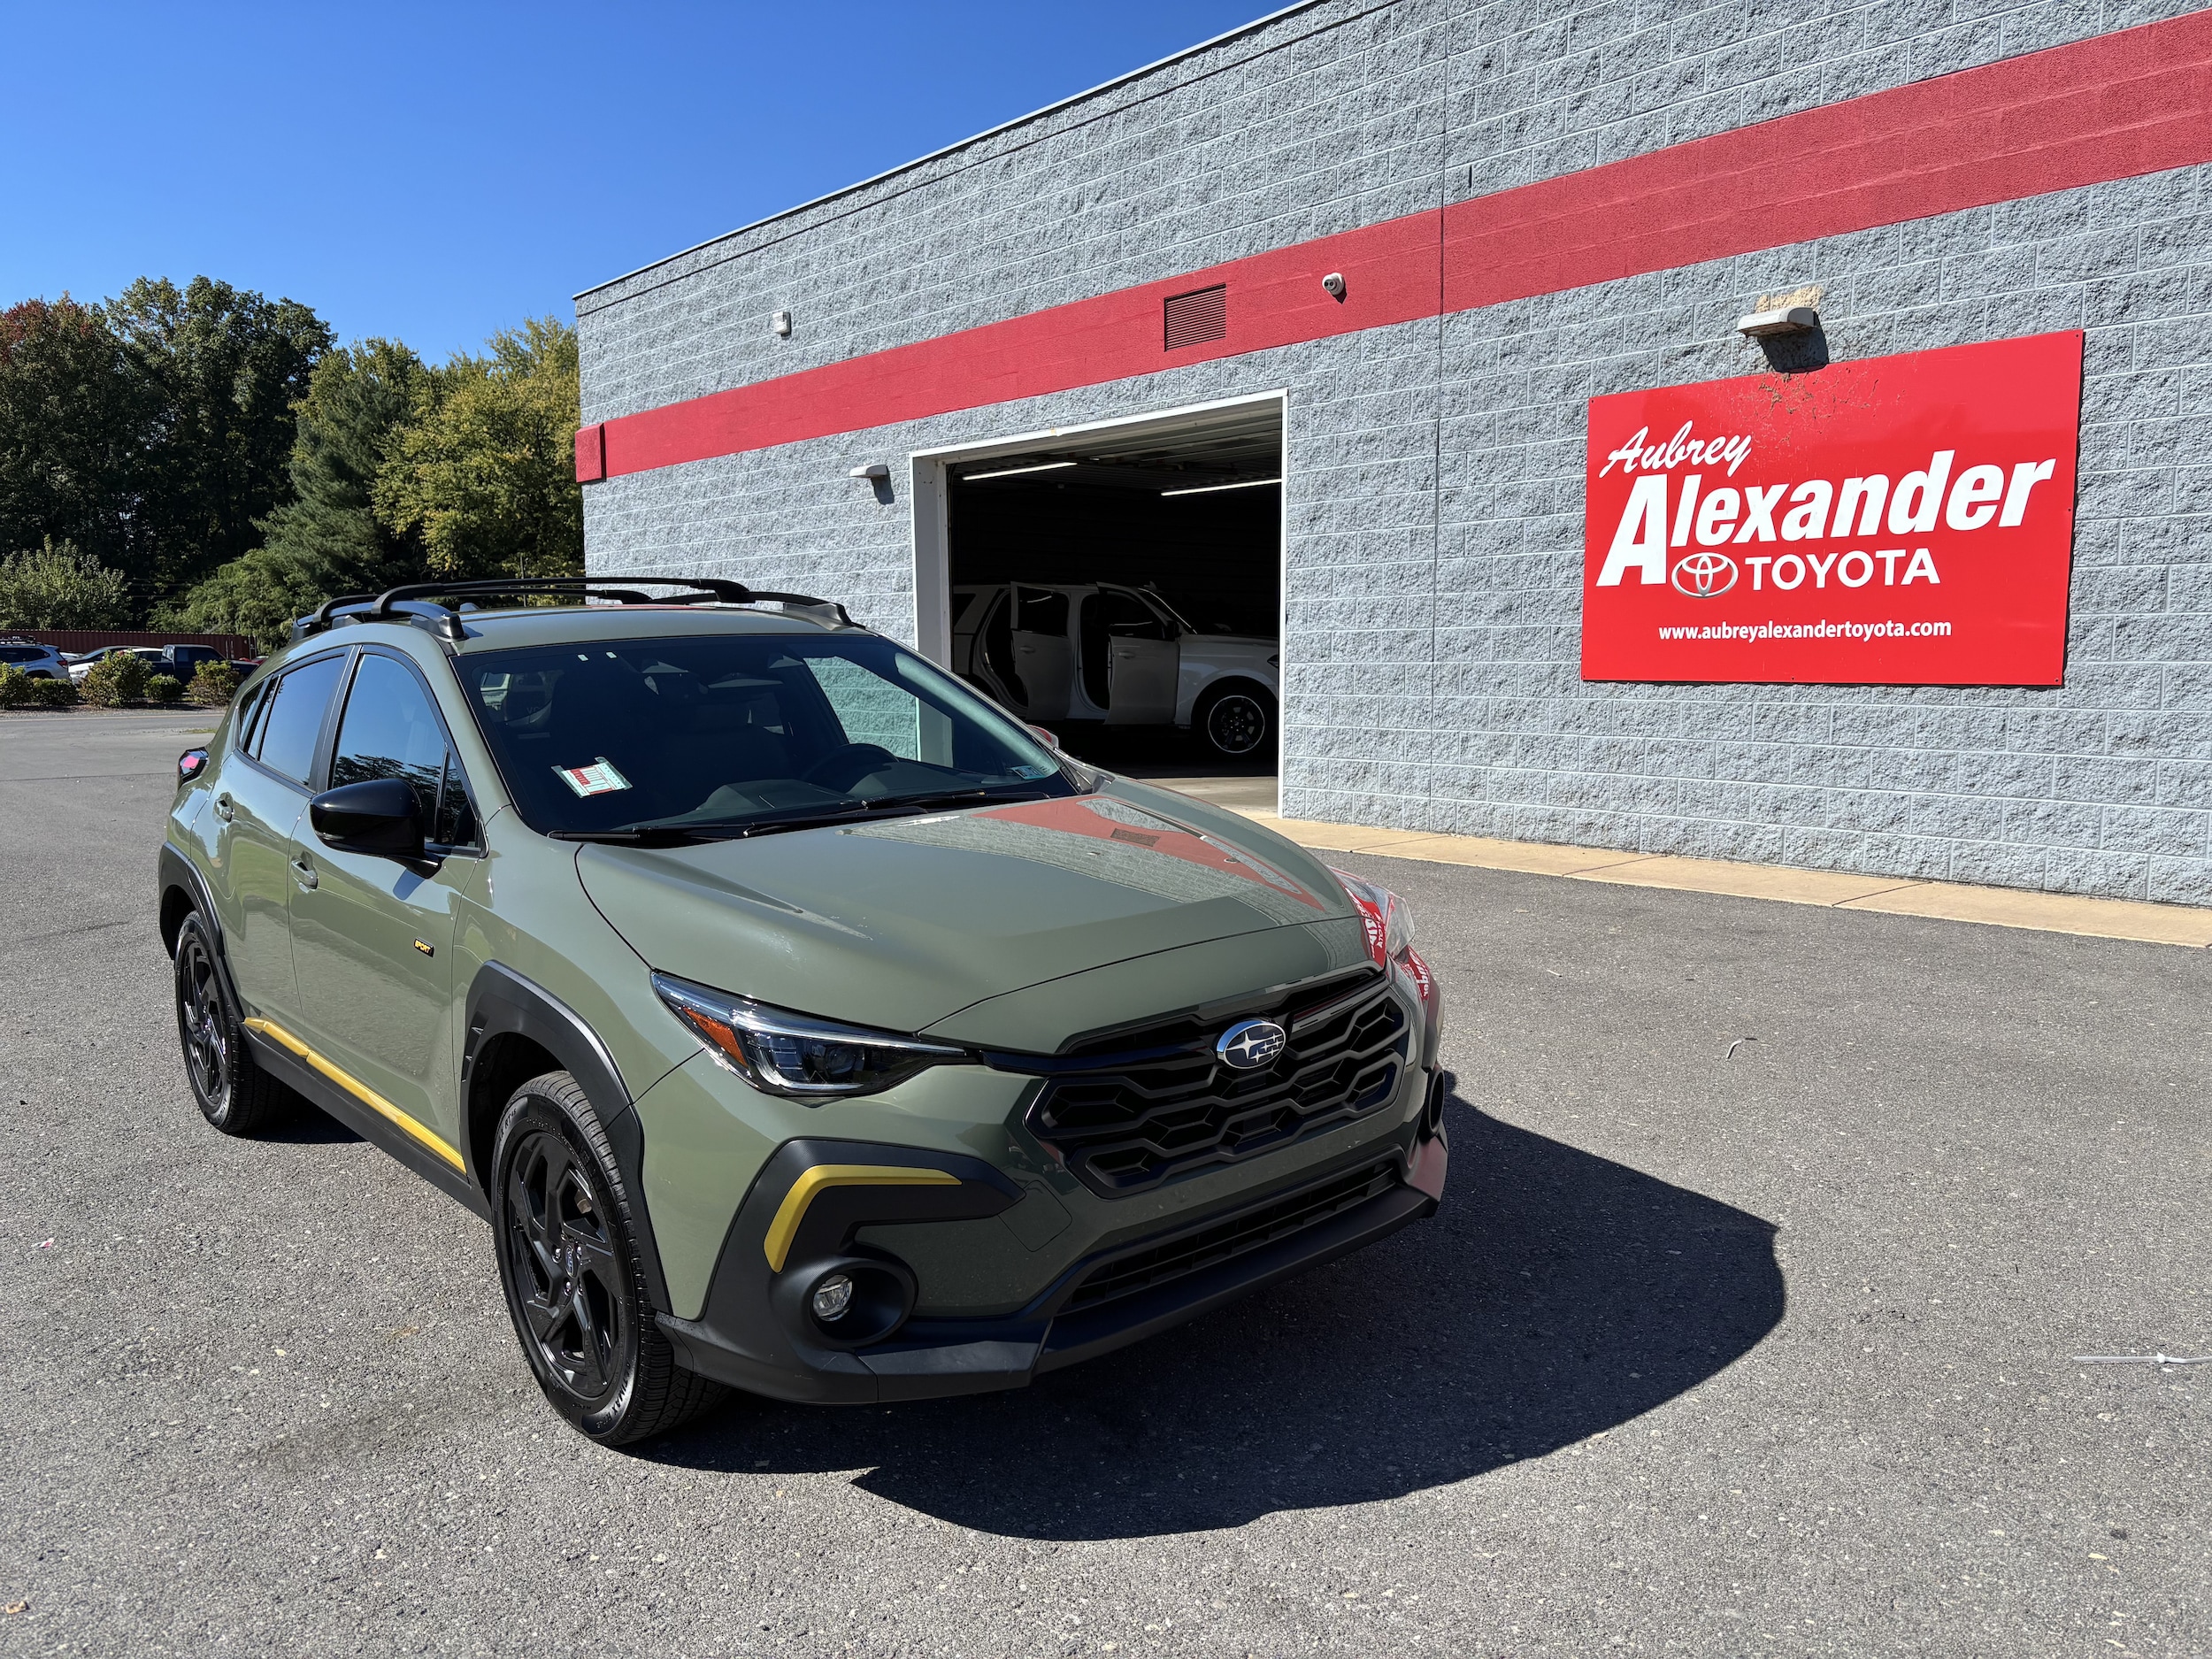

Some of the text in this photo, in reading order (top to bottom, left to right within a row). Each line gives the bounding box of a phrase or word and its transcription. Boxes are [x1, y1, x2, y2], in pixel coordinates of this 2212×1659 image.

[1598, 419, 1752, 479] Aubrey
[1595, 449, 2057, 587] Alexander
[1745, 548, 1941, 591] TOYOTA
[1658, 618, 1952, 643] www.aubreyalexandertoyota.com
[415, 940, 431, 953] SPORT
